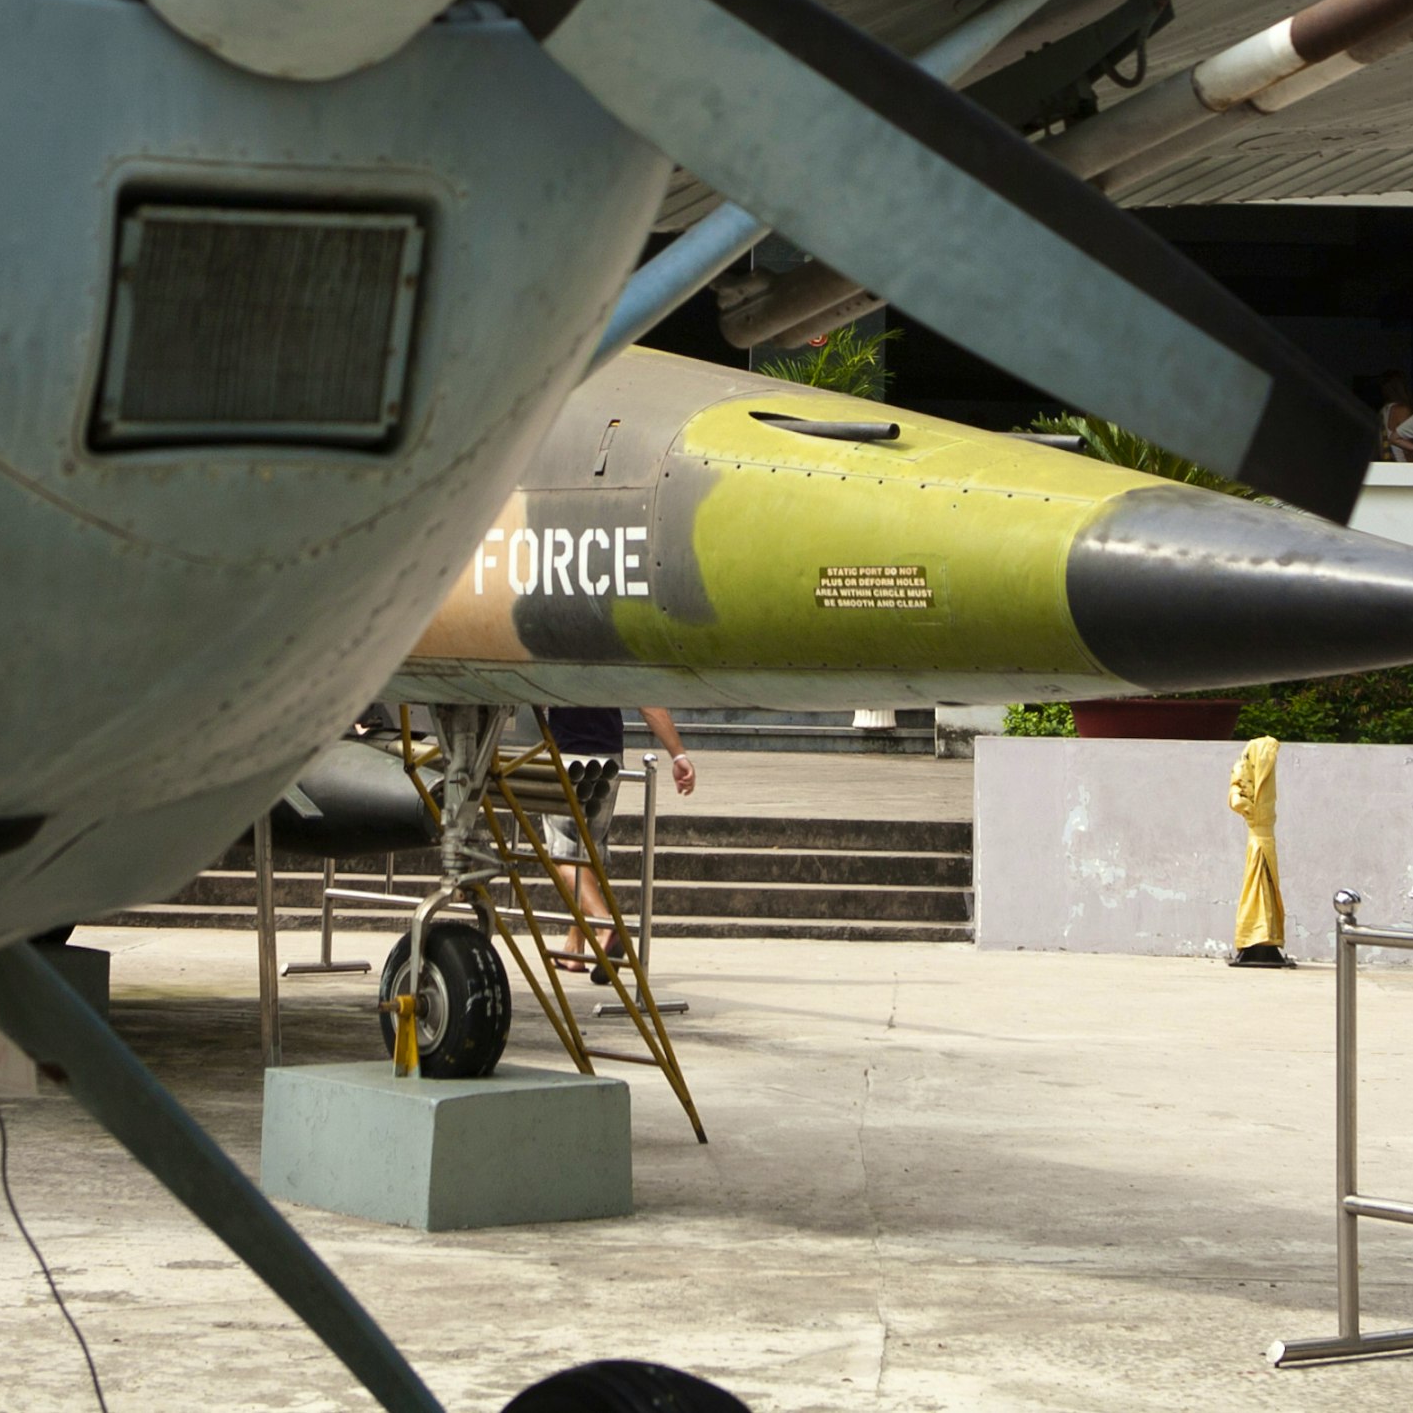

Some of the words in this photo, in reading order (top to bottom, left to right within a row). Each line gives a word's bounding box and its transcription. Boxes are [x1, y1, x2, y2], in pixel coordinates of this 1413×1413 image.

[474, 526, 649, 596] FORCE
[827, 567, 858, 577] STATIC
[859, 567, 882, 576] PORT
[884, 567, 898, 576] DO
[899, 567, 918, 576] NOT
[844, 578, 857, 587] OR
[858, 578, 895, 587] DEFORM
[896, 578, 926, 587] HOLES
[815, 588, 839, 597] AREA
[839, 589, 872, 597] WITHIN
[873, 589, 905, 598] CIRCLE
[907, 589, 933, 598] MUST
[824, 598, 836, 607] BE
[837, 599, 875, 608] SMOOTH
[876, 599, 895, 608] AND
[896, 599, 927, 608] CLEAN
